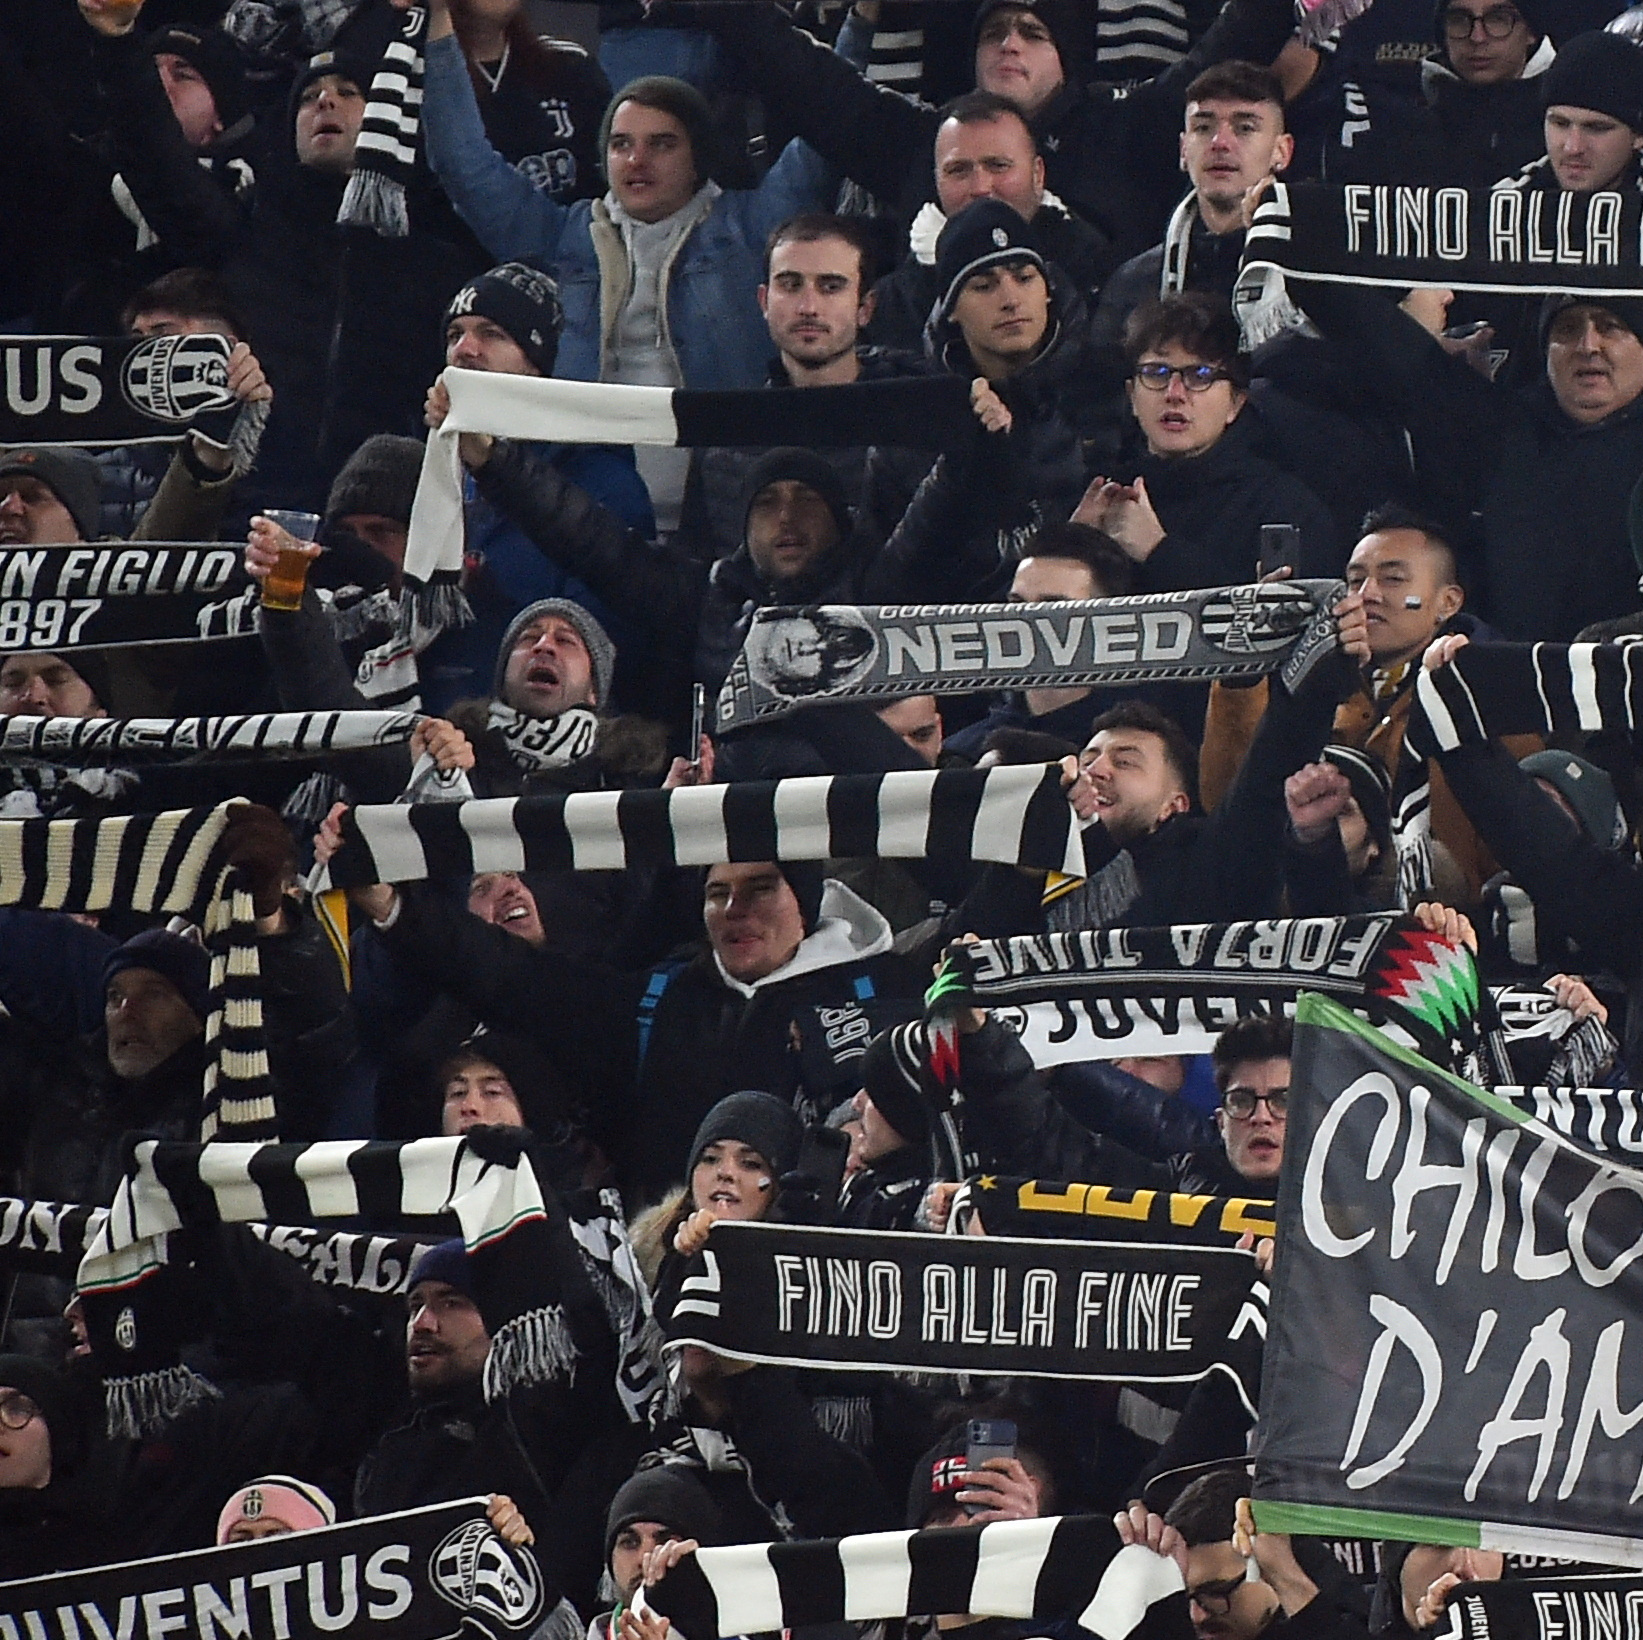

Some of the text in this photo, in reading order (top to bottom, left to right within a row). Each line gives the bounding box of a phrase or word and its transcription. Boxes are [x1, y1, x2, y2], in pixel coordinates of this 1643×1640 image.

[1345, 184, 1470, 261] FINO
[1488, 187, 1622, 267] ALLA
[54, 548, 239, 596] FIGLIO
[0, 600, 102, 650] 897
[886, 610, 1196, 677] NEDVED
[774, 1253, 1202, 1352] FINO ALLA FINE
[0, 1543, 414, 1640] JUVENTUS
